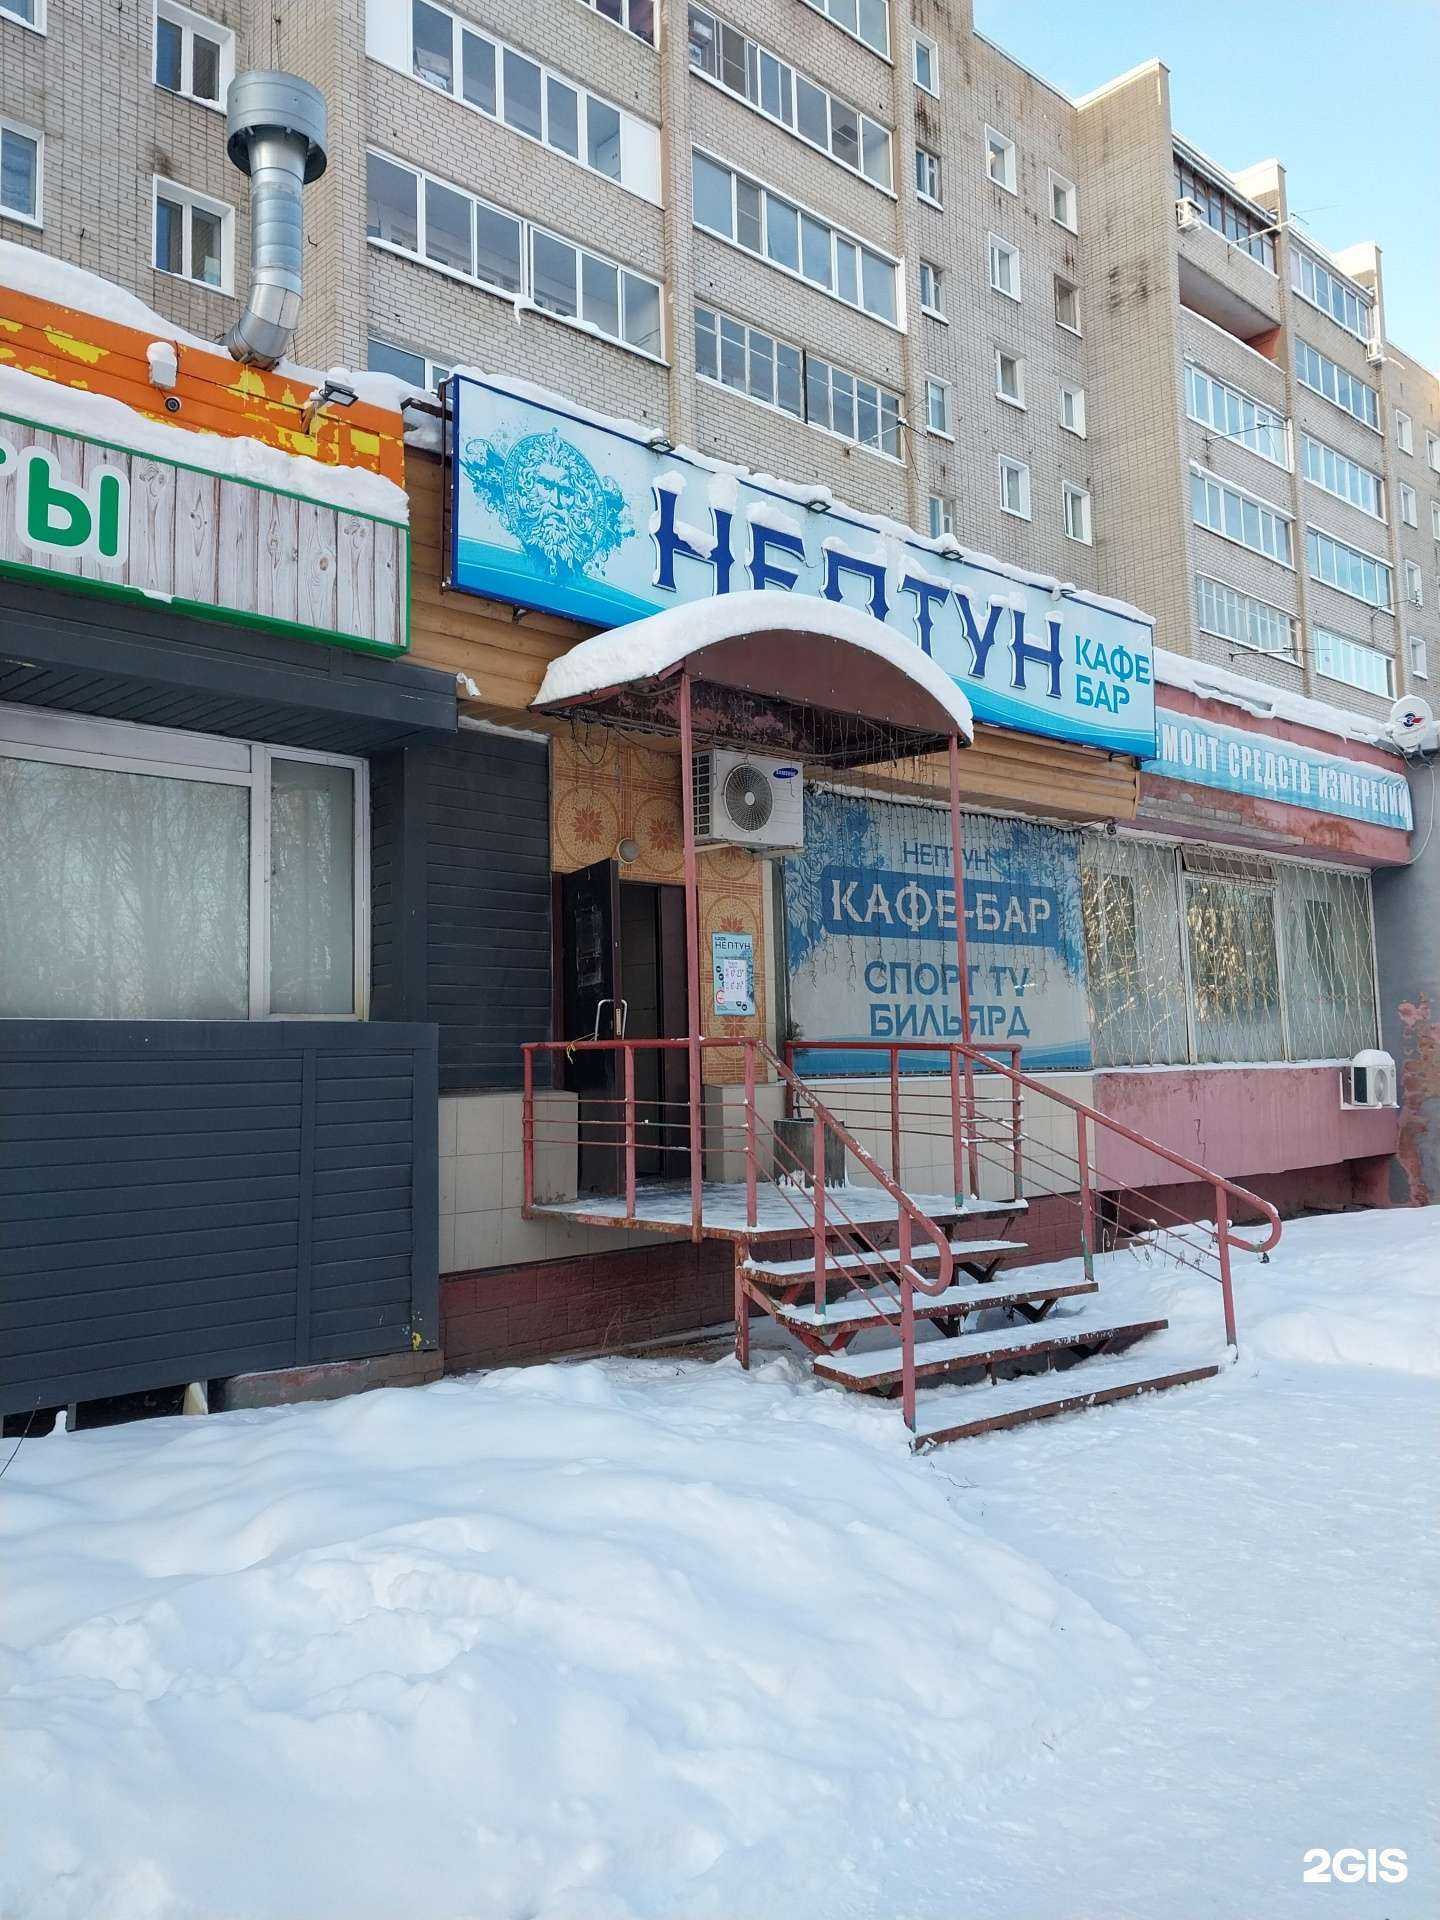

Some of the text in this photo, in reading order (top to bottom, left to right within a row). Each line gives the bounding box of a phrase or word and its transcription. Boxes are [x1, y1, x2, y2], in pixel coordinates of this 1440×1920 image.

[0, 447, 119, 557] Ы
[649, 486, 1064, 699] НЕПТУН
[1075, 634, 1151, 686] КАФЕ
[1075, 673, 1130, 714] БАР
[1228, 742, 1311, 794] СРЕДСТВ
[903, 840, 990, 872] НЕПУН
[831, 879, 1051, 934] КАФЕ-БАР
[988, 965, 1030, 998] TV
[869, 1003, 1031, 1039] БИЛЬЯРД
